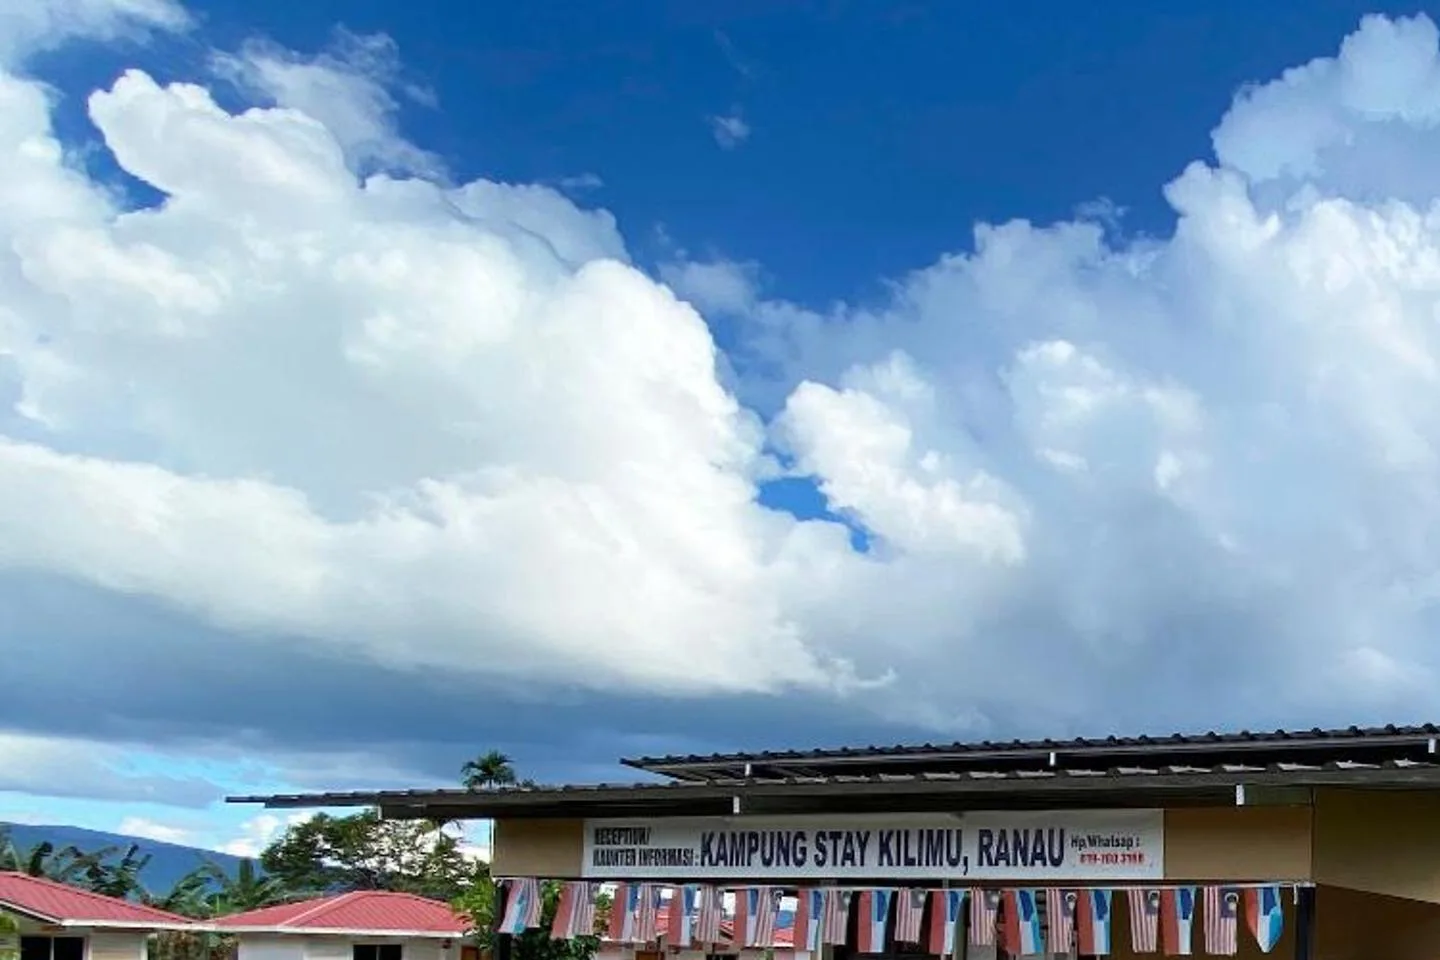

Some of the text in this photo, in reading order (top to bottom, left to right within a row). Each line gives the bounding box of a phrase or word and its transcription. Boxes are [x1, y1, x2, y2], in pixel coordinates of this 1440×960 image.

[701, 827, 1066, 876] KAMPUNG STAY KILIMU, RANAU
